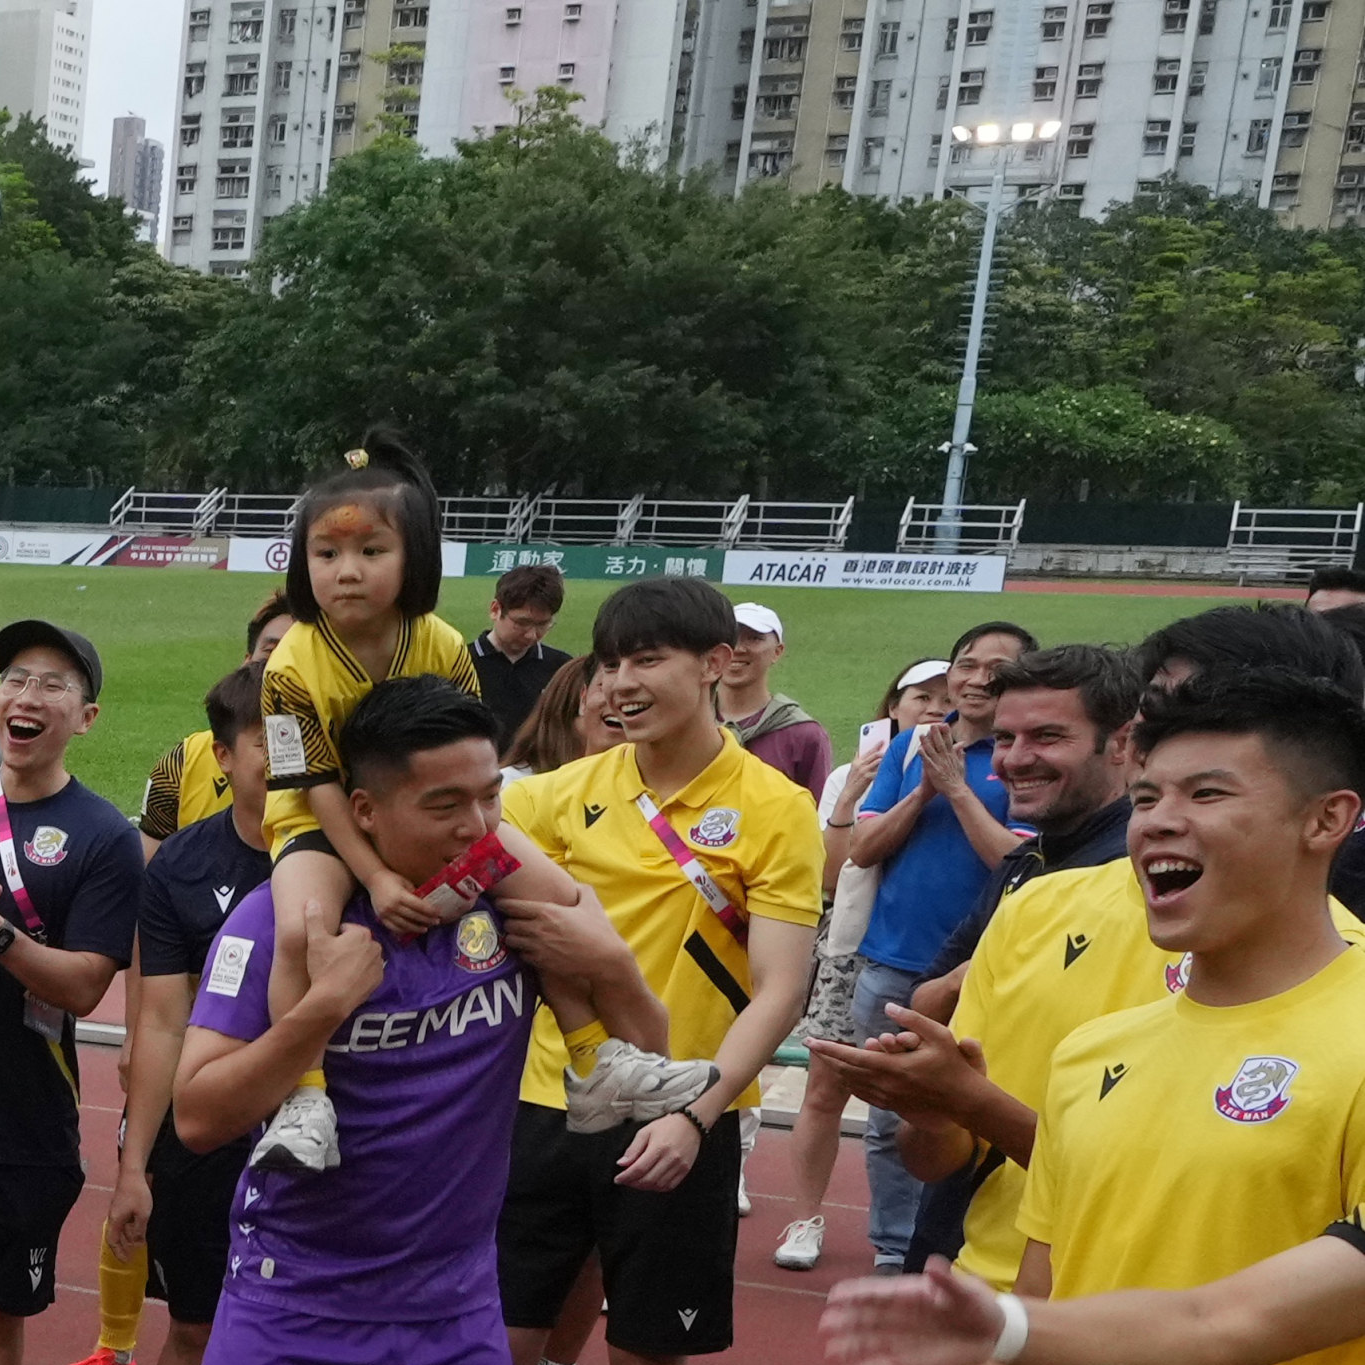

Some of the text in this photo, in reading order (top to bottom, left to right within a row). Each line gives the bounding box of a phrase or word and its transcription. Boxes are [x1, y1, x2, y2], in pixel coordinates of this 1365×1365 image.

[749, 562, 827, 583] ATACAR
[841, 575, 972, 588] www.atacar.com.hk
[691, 834, 708, 846] LEE
[29, 852, 57, 865] LEE MAN
[471, 962, 489, 971] LEE
[417, 973, 524, 1044] MAN
[1220, 1103, 1270, 1122] LEE MAN
